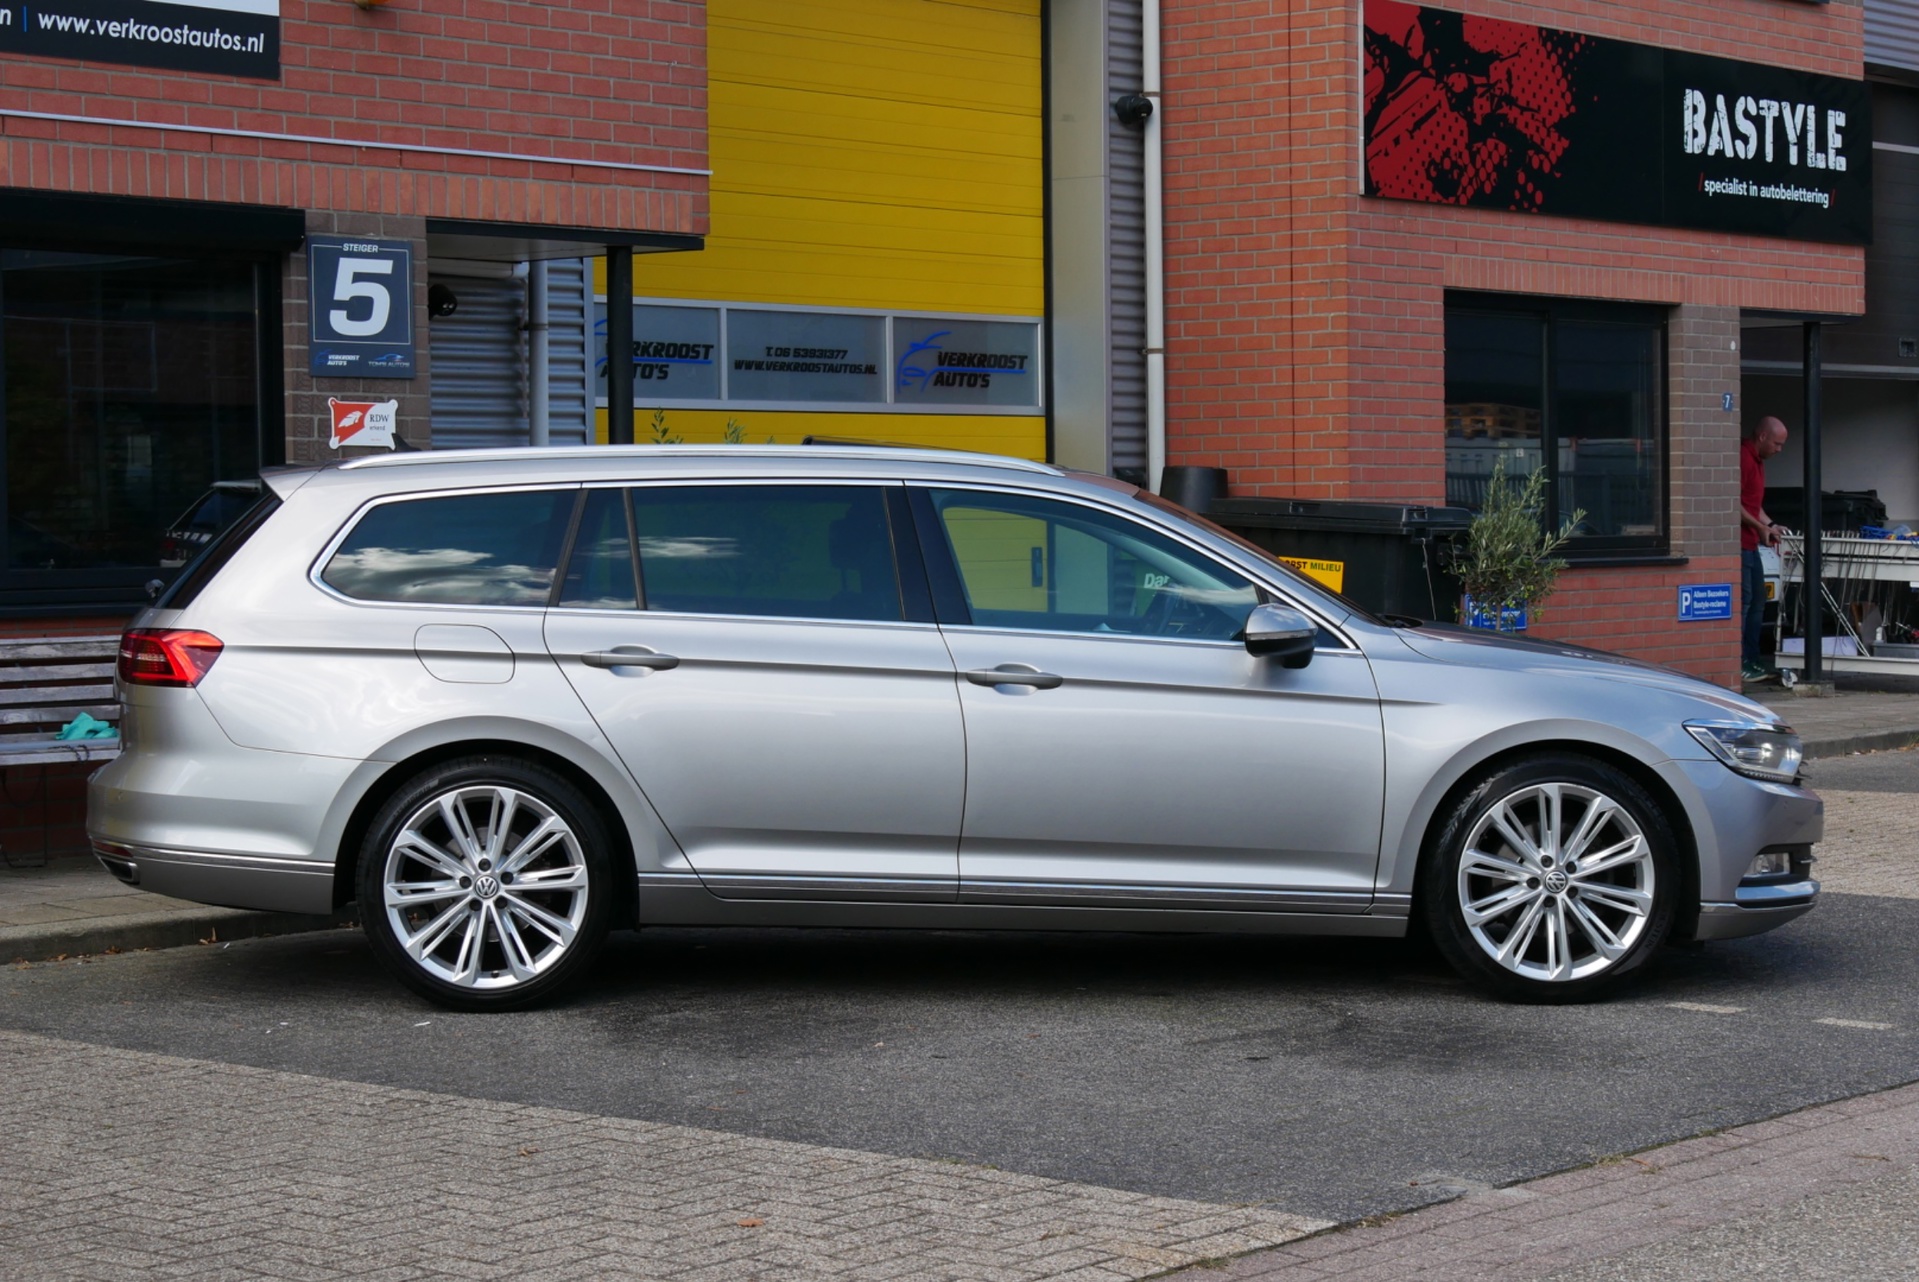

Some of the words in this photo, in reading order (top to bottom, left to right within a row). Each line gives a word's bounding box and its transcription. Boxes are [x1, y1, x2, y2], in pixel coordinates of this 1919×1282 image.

[38, 12, 265, 53] www.verkroostautos.nl
[1683, 88, 1847, 171] BASTYLE
[1704, 178, 1747, 196] specialist
[1749, 181, 1759, 197] in
[1760, 183, 1830, 208] autobelettering
[343, 243, 379, 253] STEIGER
[329, 257, 394, 336] 5
[774, 347, 791, 358] 06
[937, 351, 1028, 370] VERKROOST
[734, 359, 878, 375] WWW.VERKROOSTAUTOS.NL
[933, 371, 992, 388] AUTO'S
[369, 413, 389, 423] RDW
[1310, 561, 1342, 572] MILIEU
